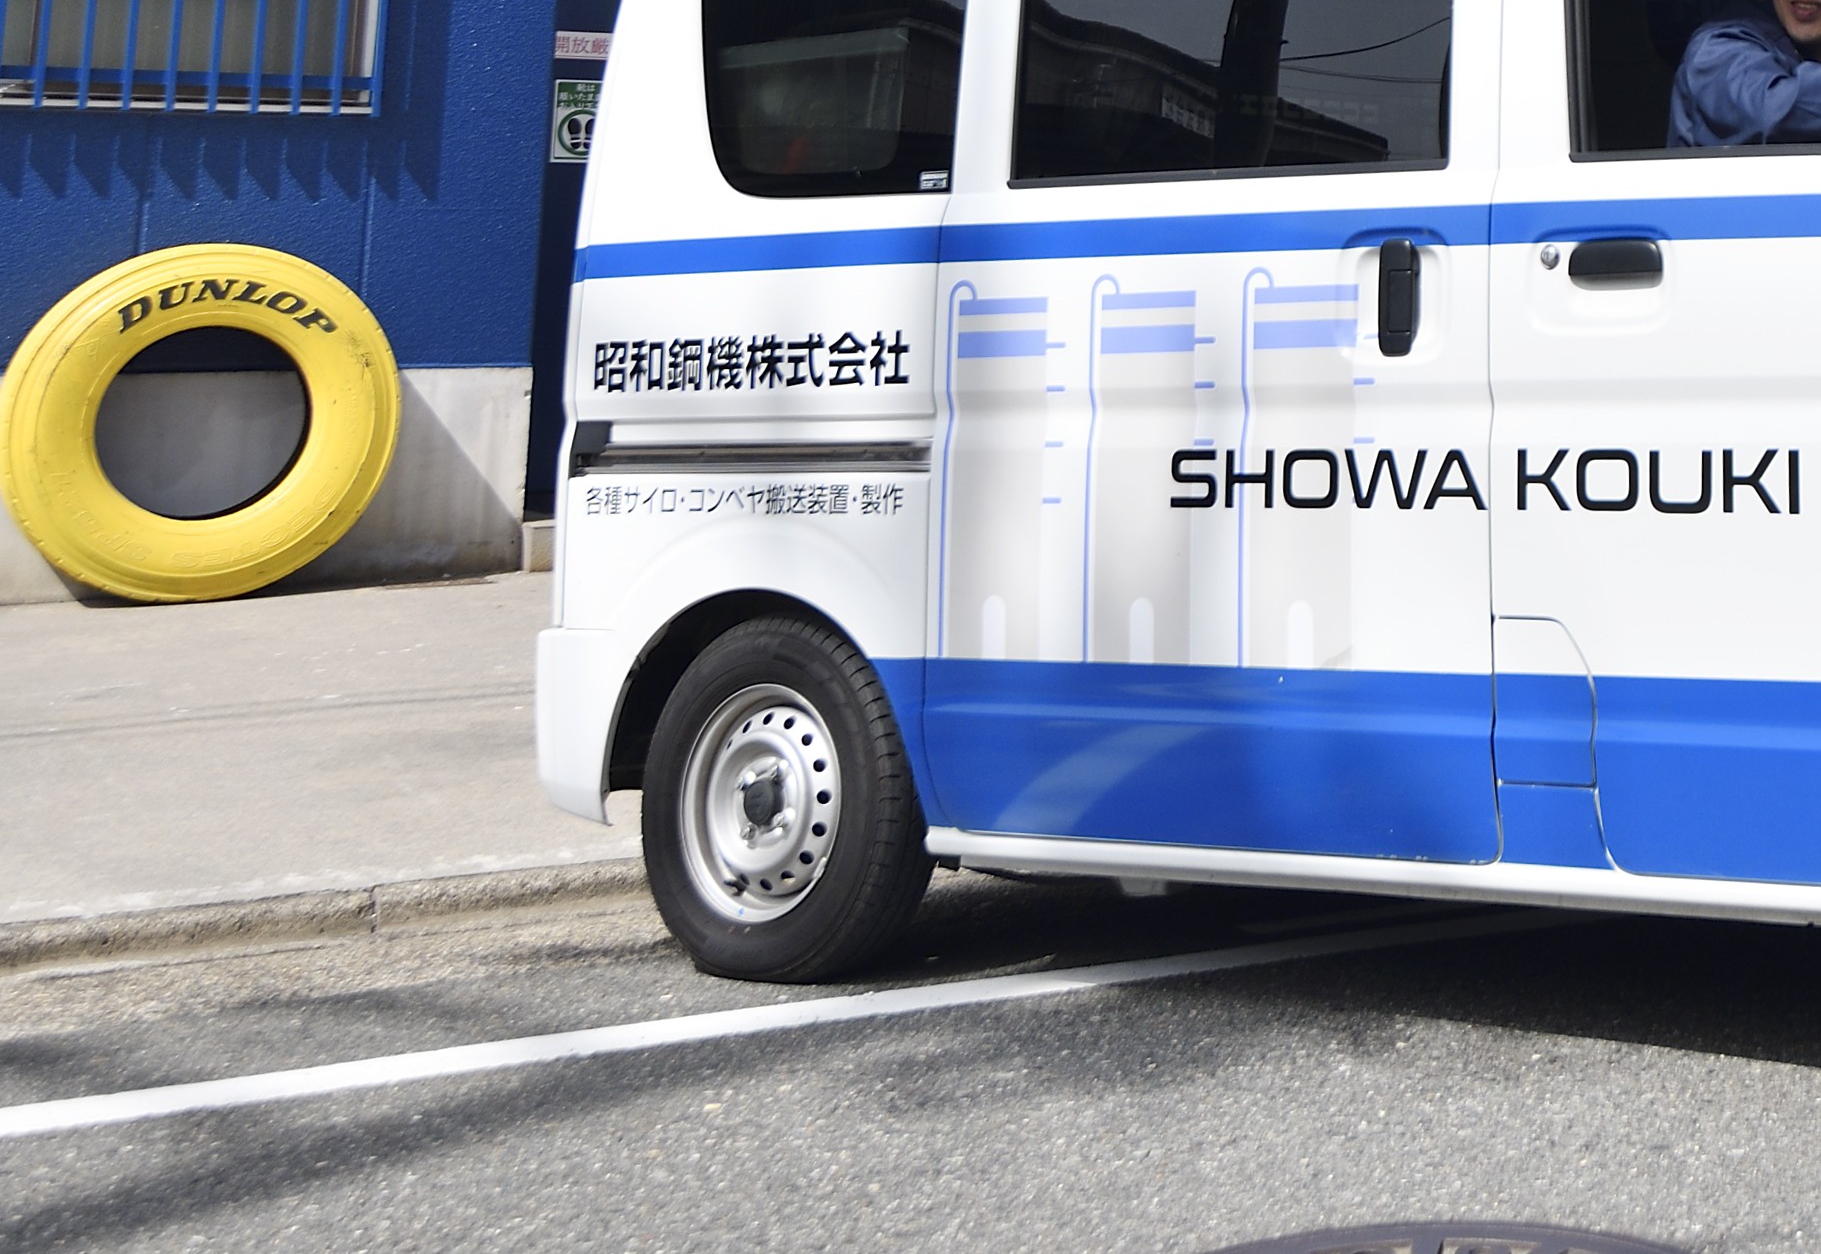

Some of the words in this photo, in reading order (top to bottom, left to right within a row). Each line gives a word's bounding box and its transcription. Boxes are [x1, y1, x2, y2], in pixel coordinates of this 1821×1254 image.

[116, 277, 339, 335] DUNLOP
[593, 329, 910, 394] 昭和鋼機株式会社
[1169, 448, 1488, 512] SHOWA
[1516, 448, 1801, 515] KOUKI
